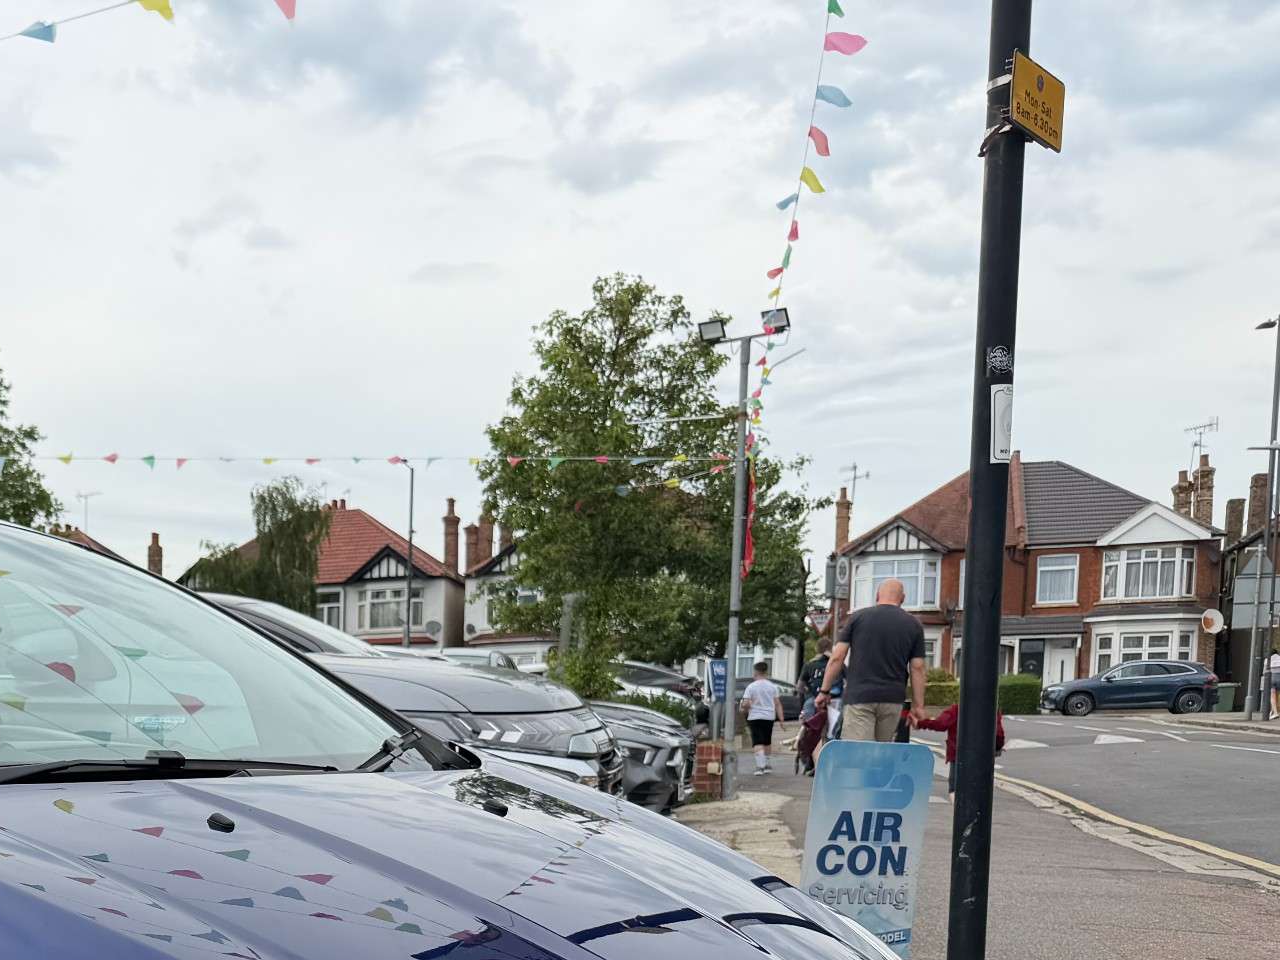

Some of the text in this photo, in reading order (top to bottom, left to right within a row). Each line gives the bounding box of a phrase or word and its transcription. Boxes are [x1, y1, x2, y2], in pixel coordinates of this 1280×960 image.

[828, 810, 903, 843] AIR
[816, 844, 908, 877] CON
[809, 881, 908, 911] Servicing
